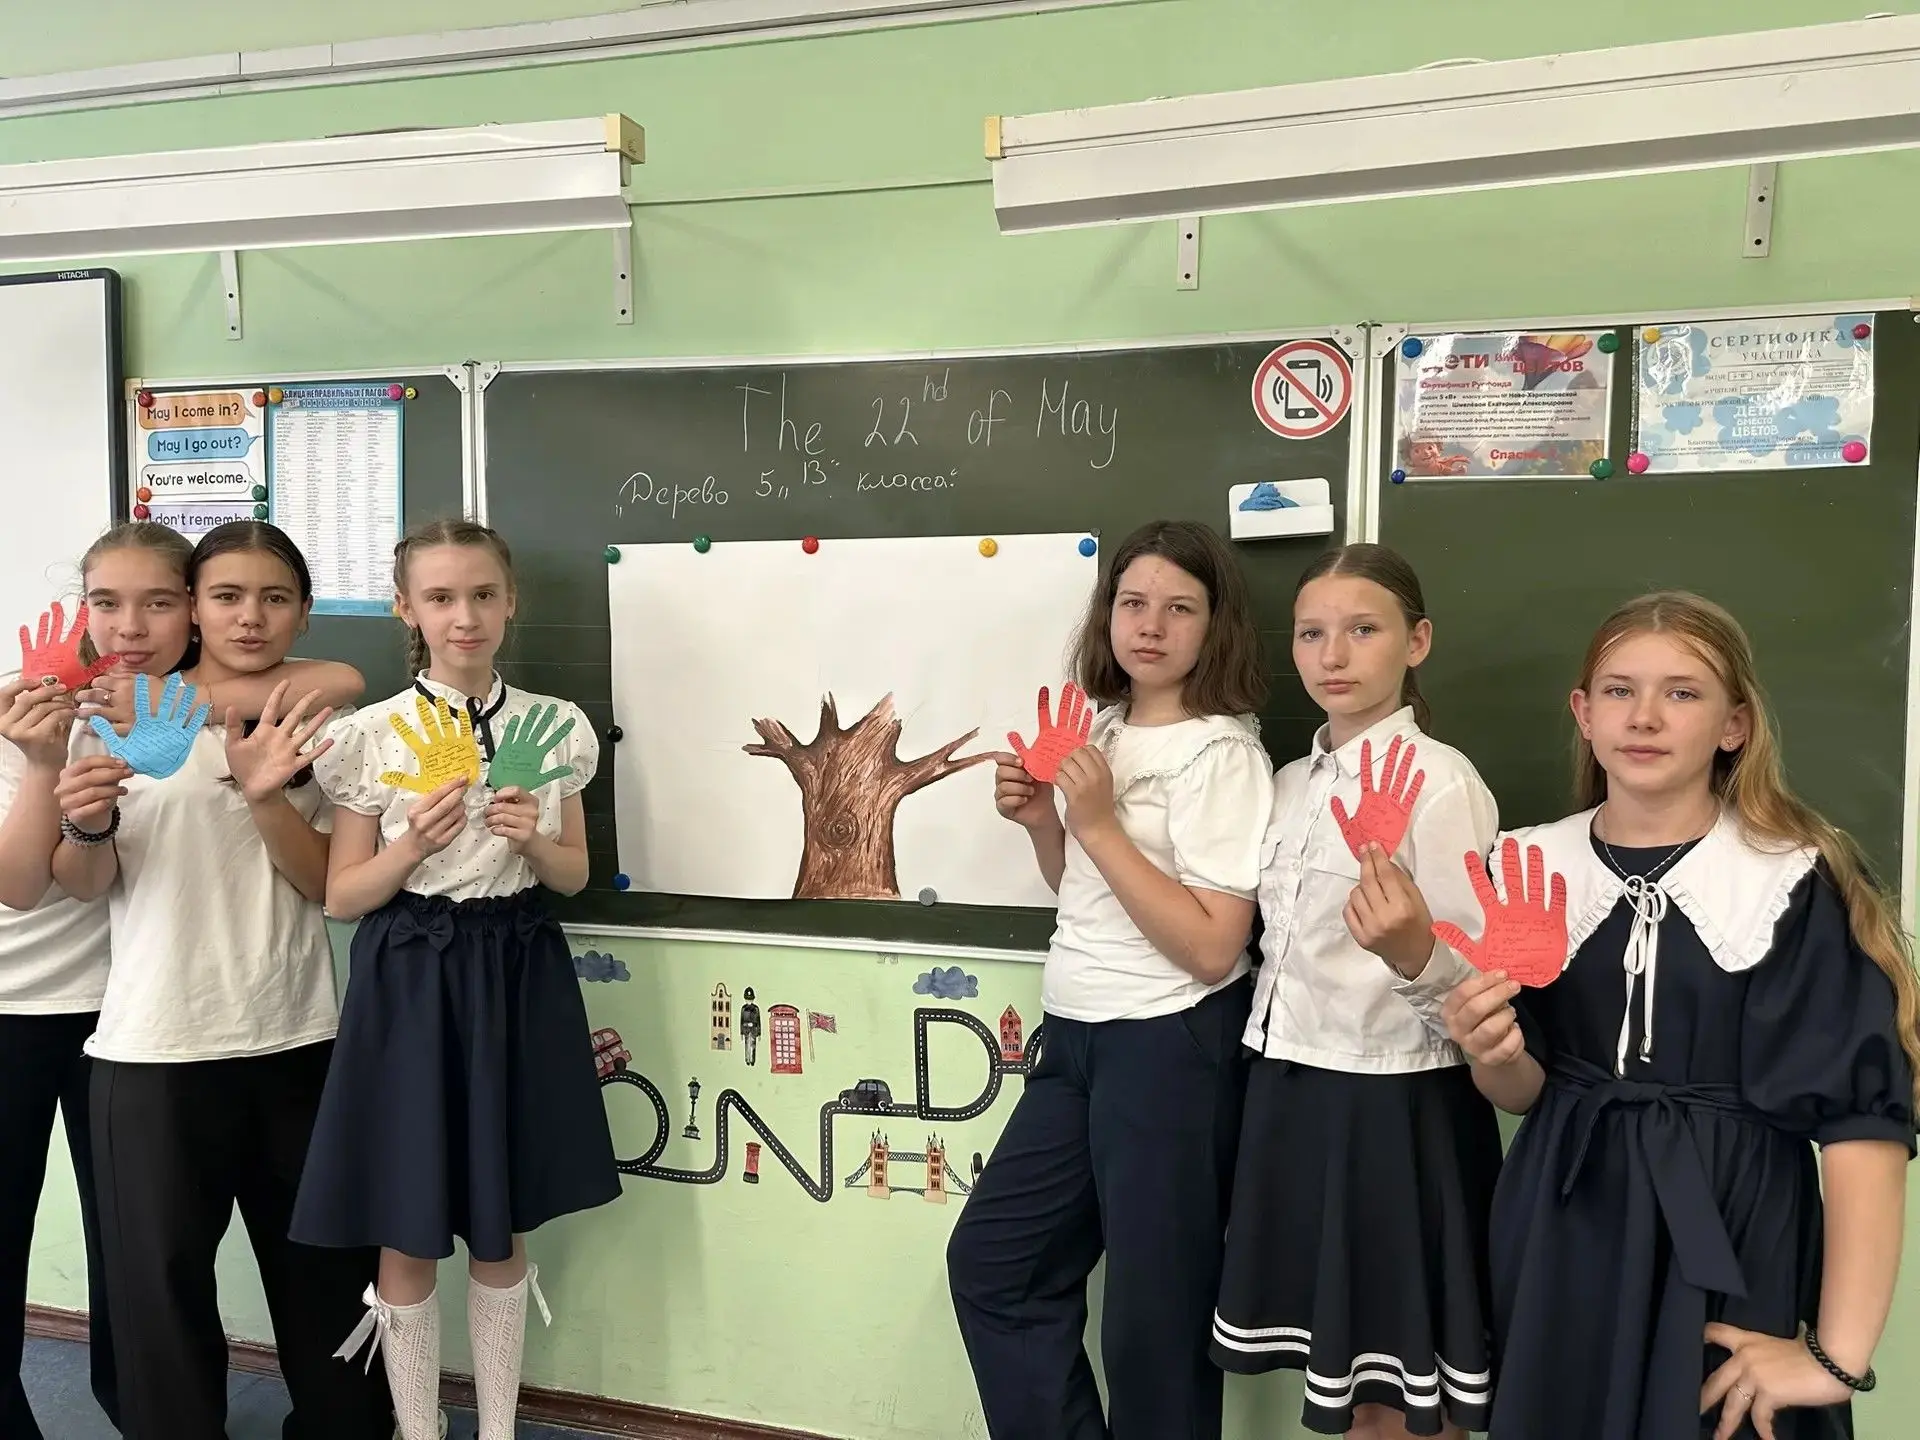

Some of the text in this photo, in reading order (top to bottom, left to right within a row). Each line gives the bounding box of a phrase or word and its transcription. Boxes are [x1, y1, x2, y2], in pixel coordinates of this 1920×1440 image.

[57, 271, 89, 280] HITACHI
[1711, 329, 1847, 348] СЕРТИФИКА
[306, 388, 360, 398] НЕПРАВИЛЬНЫХ
[146, 402, 240, 422] May I come in?
[735, 372, 827, 455] The
[967, 389, 1012, 447] of
[1036, 377, 1119, 469] May
[1731, 425, 1779, 438] ЦВЕТОВ
[157, 436, 242, 454] May I go out?
[146, 471, 248, 487] You're welcome.
[155, 512, 186, 526] don't
